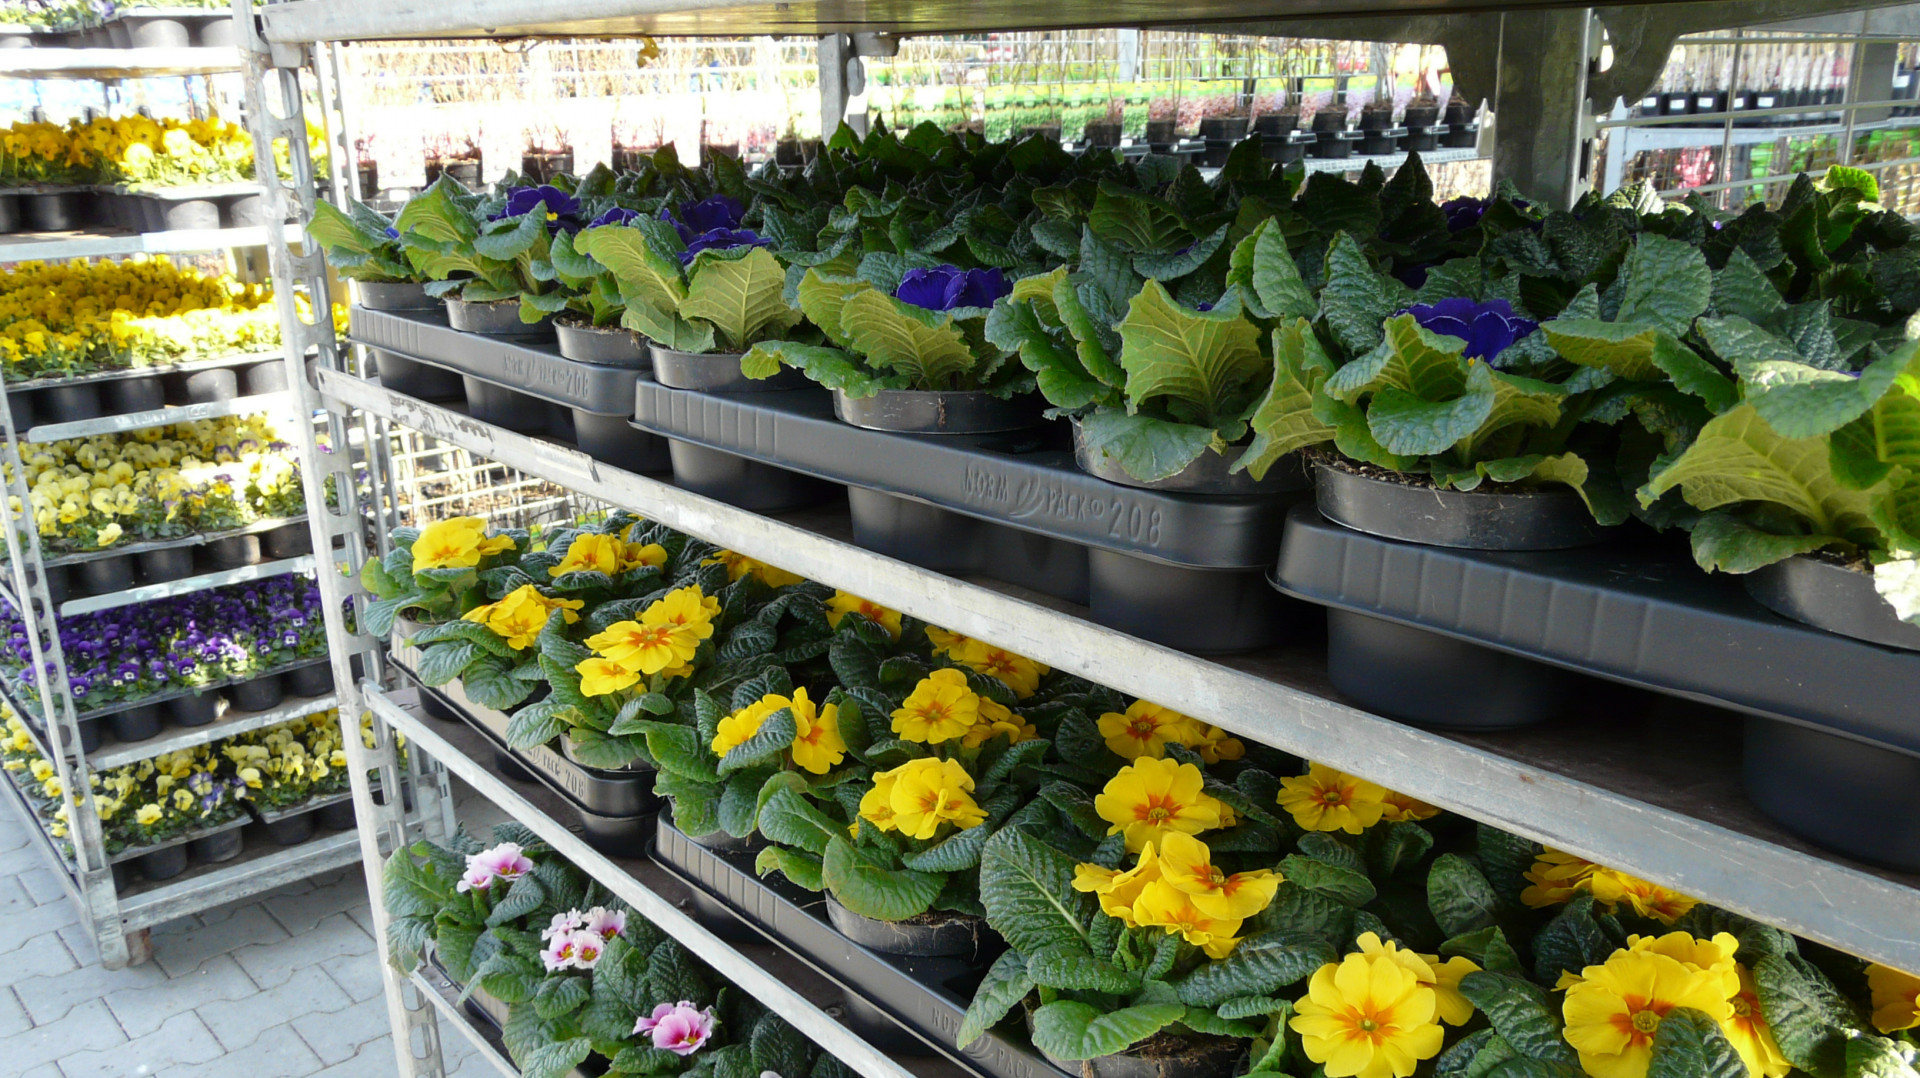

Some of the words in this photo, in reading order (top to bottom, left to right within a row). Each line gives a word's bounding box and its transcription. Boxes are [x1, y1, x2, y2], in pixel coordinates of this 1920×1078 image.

[565, 368, 589, 400] 208
[1108, 501, 1162, 548] 208
[565, 769, 584, 798] 208
[931, 1006, 961, 1040] NOR
